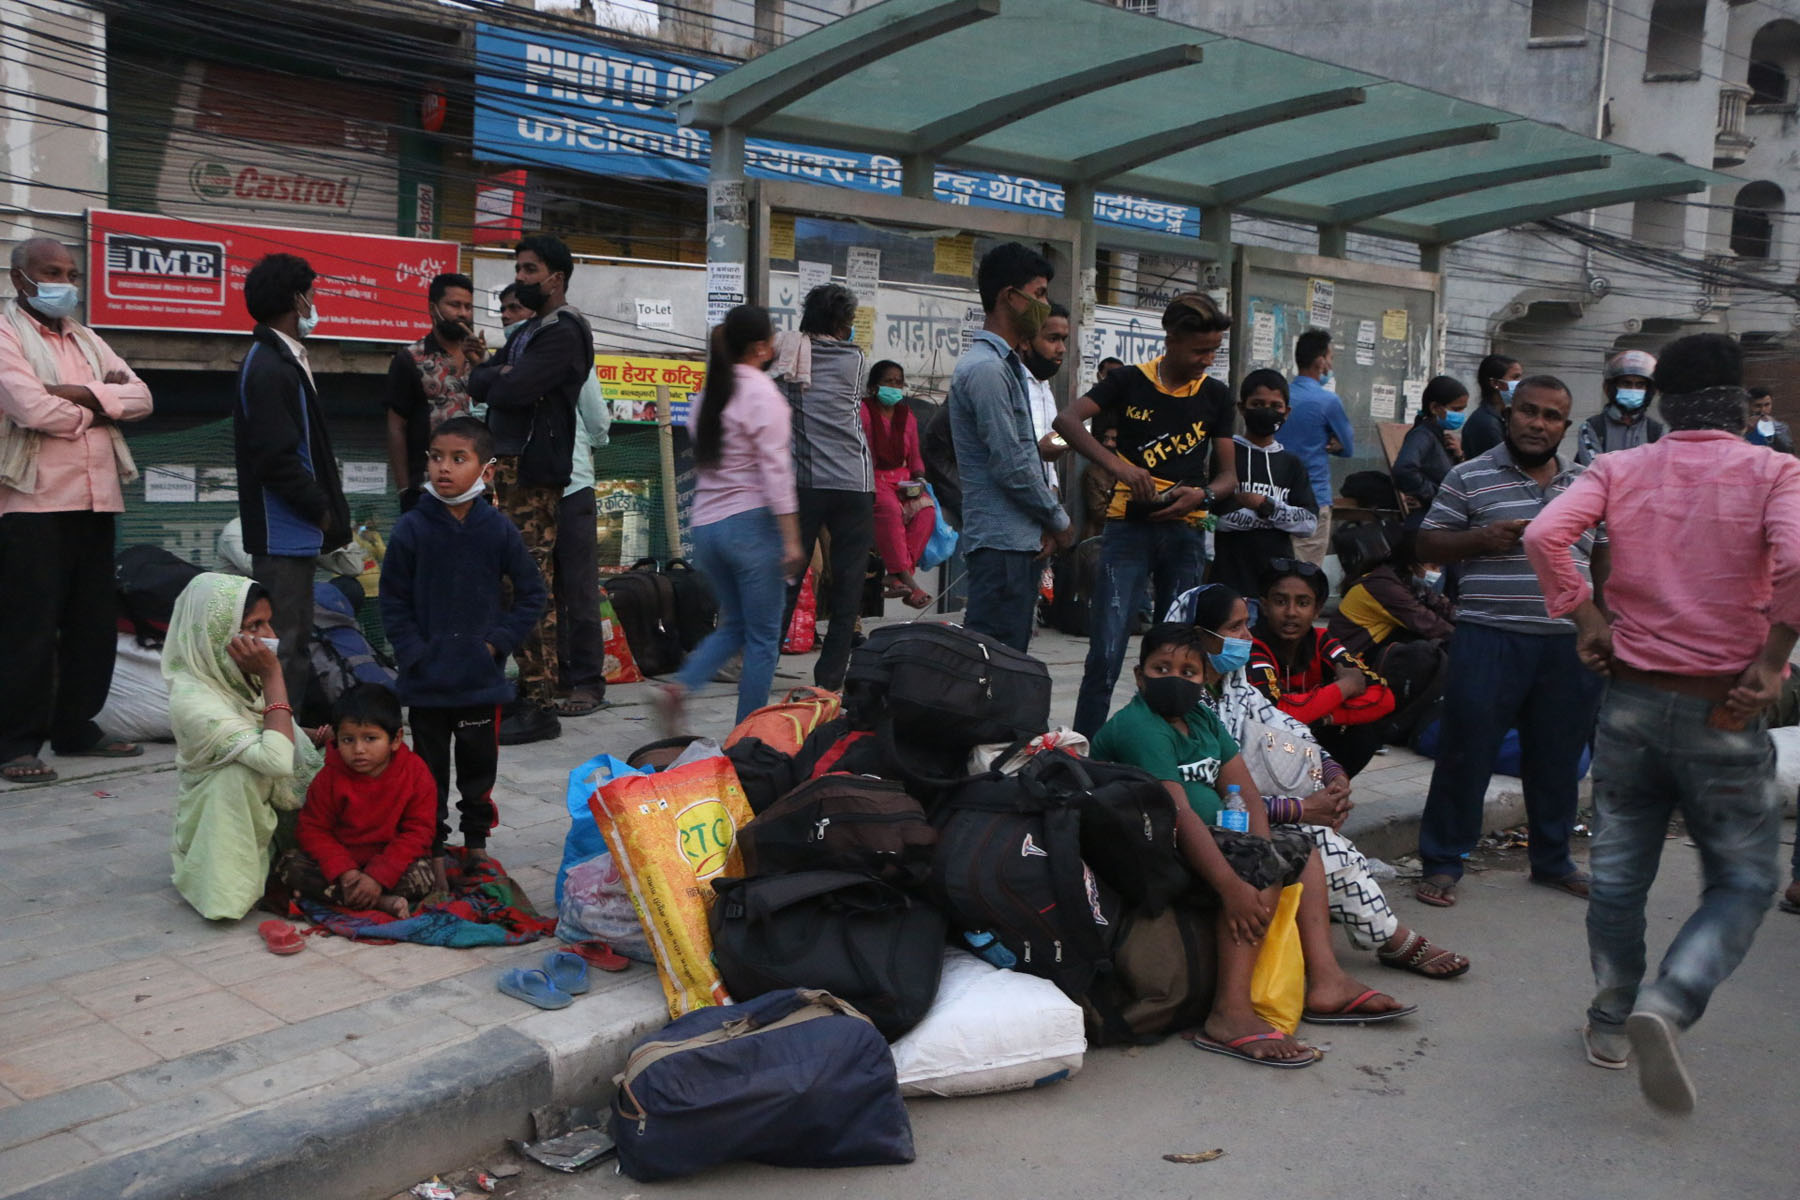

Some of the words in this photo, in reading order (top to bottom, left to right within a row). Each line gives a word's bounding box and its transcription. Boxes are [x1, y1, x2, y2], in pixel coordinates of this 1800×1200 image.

[525, 44, 657, 110] PHOTO
[234, 167, 350, 208] Castrol
[127, 245, 214, 278] IME
[638, 303, 672, 315] To-Let
[622, 362, 657, 383] हेयर
[1125, 405, 1154, 422] K&K
